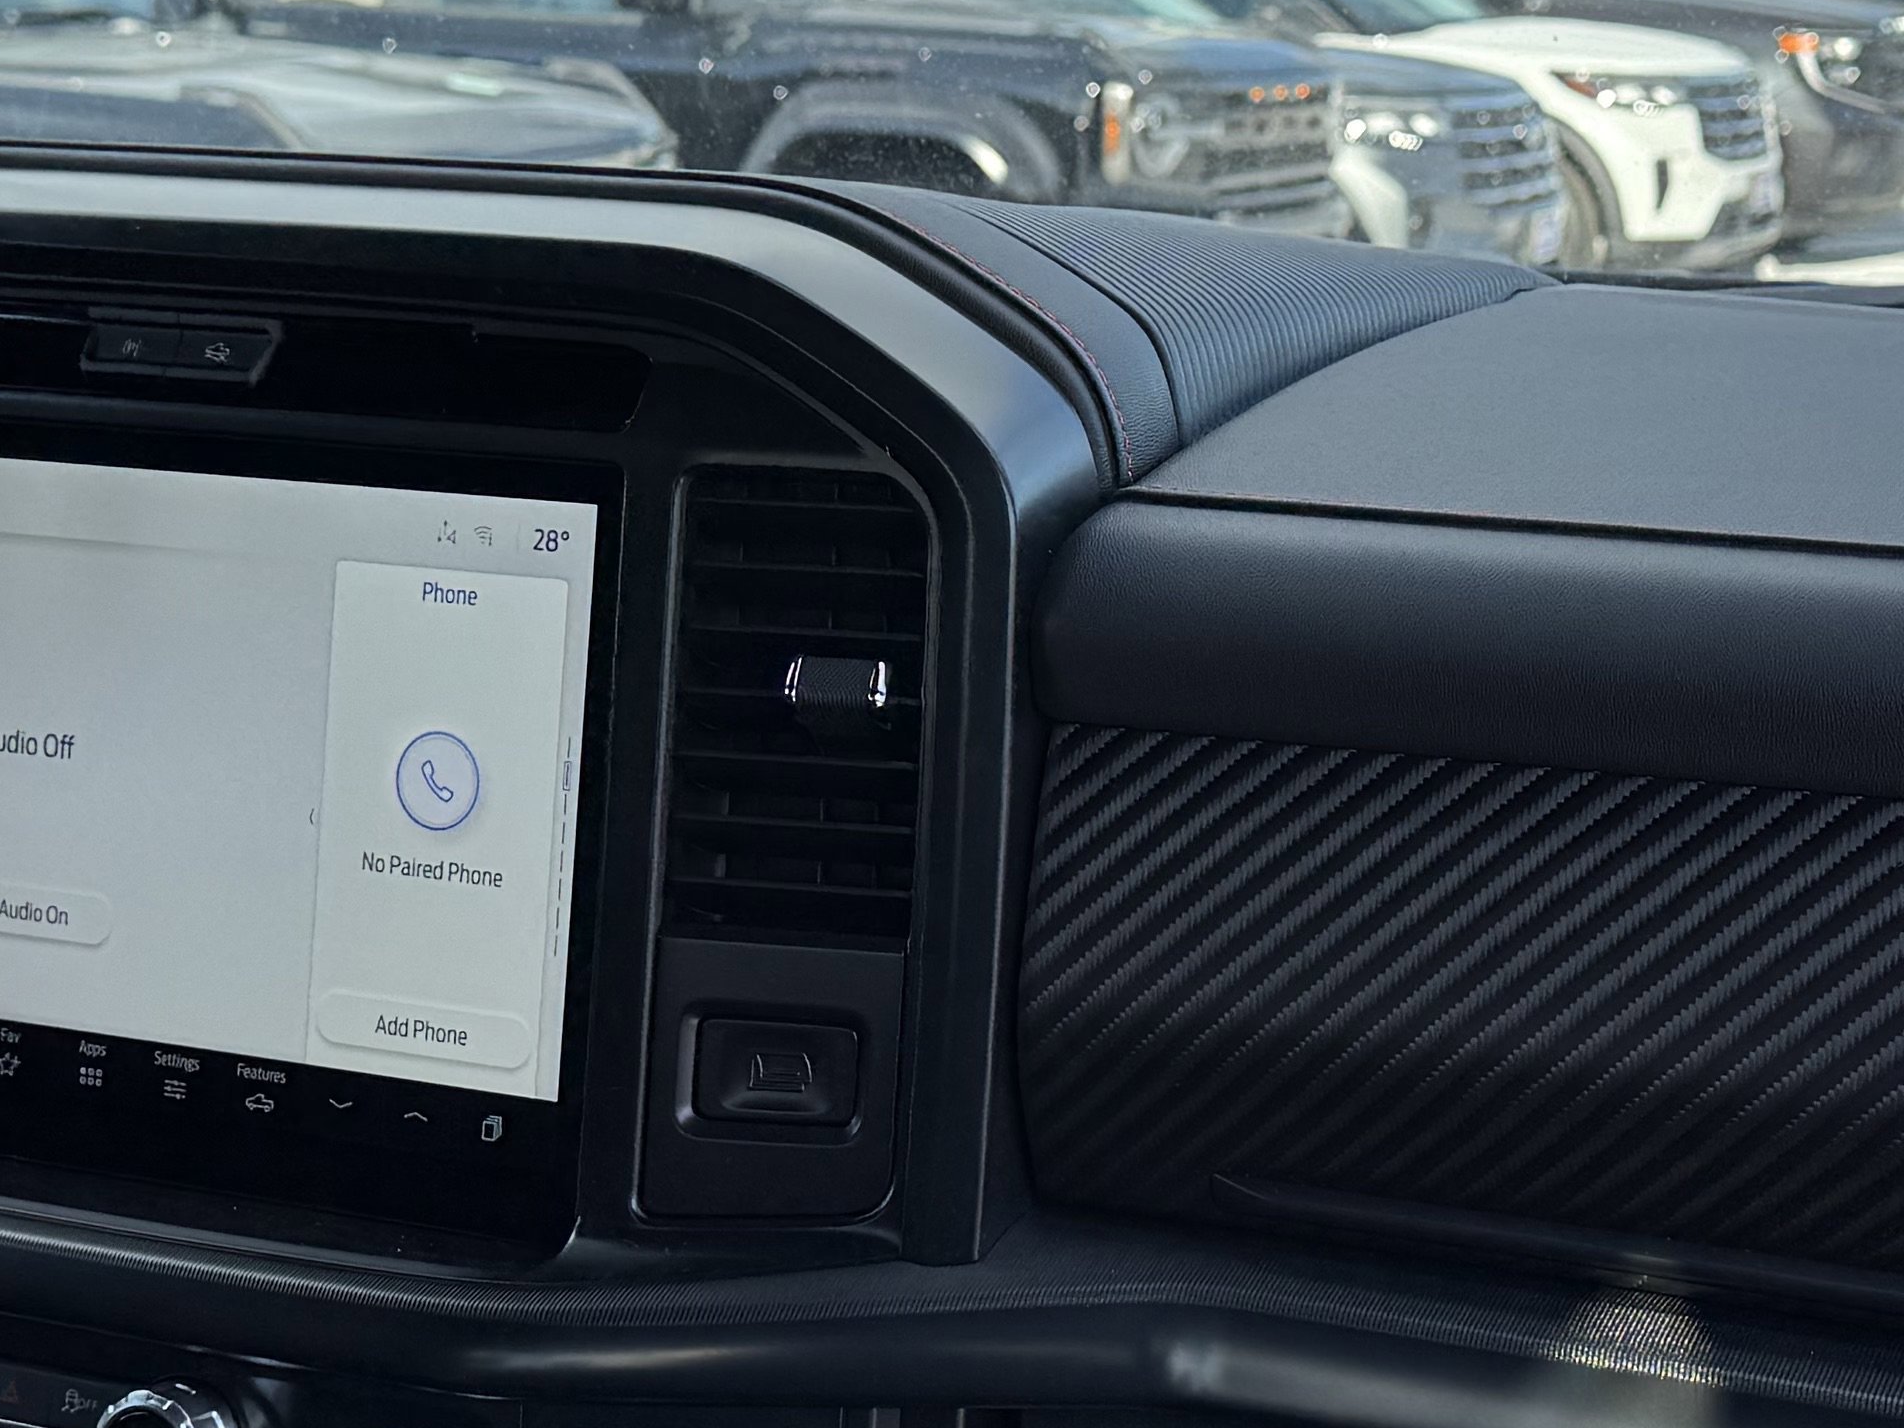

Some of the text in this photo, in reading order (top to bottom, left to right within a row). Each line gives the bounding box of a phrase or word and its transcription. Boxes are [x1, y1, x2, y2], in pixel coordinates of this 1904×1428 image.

[422, 582, 478, 606] Phone
[43, 733, 75, 759] Off
[361, 851, 503, 888] No Paired Phone
[46, 905, 69, 926] On
[0, 1027, 22, 1044] Fav
[375, 1015, 468, 1046] Add Phone
[79, 1040, 107, 1057] Apps
[154, 1050, 200, 1072] Settings
[237, 1062, 286, 1084] Features
